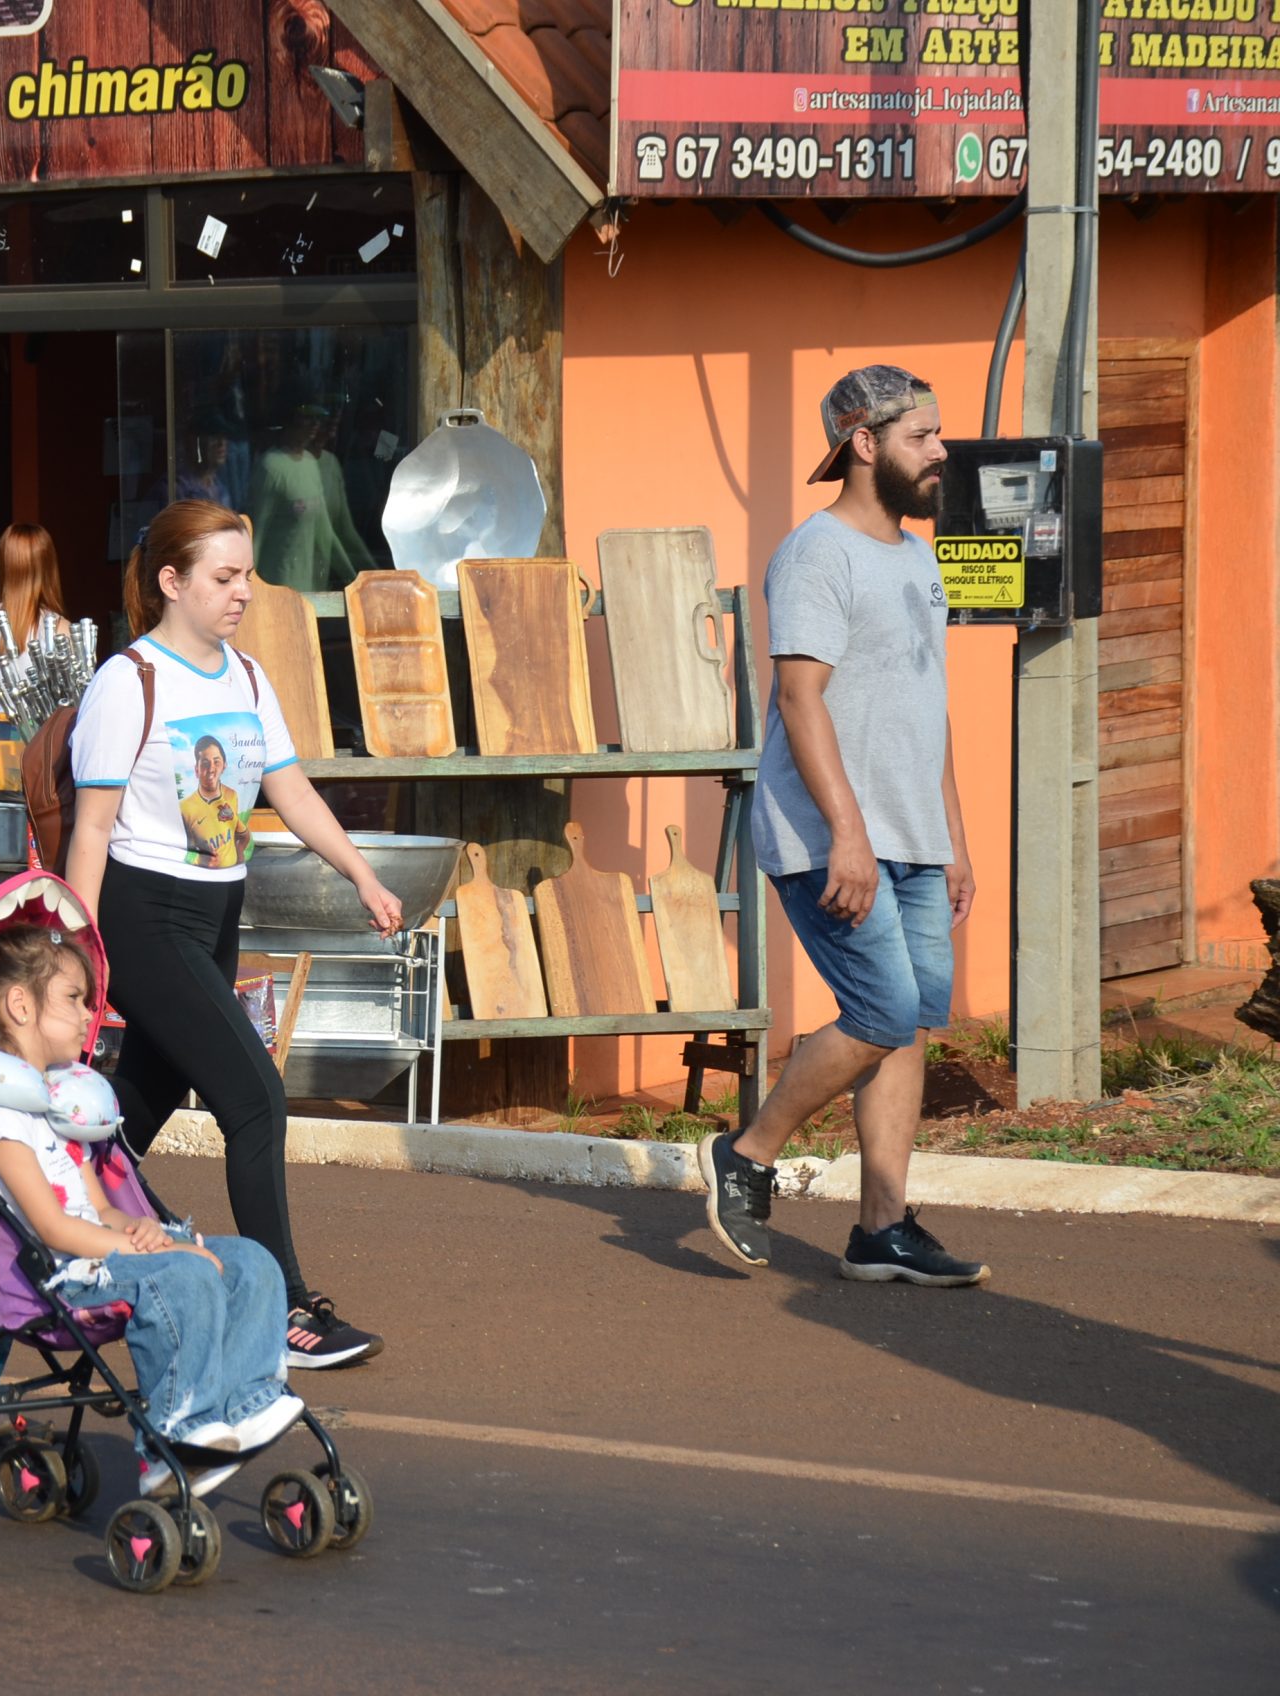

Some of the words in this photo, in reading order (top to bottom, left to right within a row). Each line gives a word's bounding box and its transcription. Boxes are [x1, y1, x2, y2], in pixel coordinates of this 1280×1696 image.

[845, 27, 904, 63] EM
[922, 30, 1018, 64] ARTE
[8, 52, 246, 119] chimarão
[810, 88, 1023, 117] artesanatojd_lojadafa
[675, 137, 720, 179] 67
[731, 137, 914, 179] 3490-1311
[988, 139, 1028, 178] 67
[1098, 138, 1221, 178] 54-2480
[1235, 138, 1251, 181] /
[937, 542, 1019, 561] CUIDADO
[944, 575, 976, 585] CHOQUE
[961, 565, 985, 574] RISCO
[986, 565, 997, 573] DE
